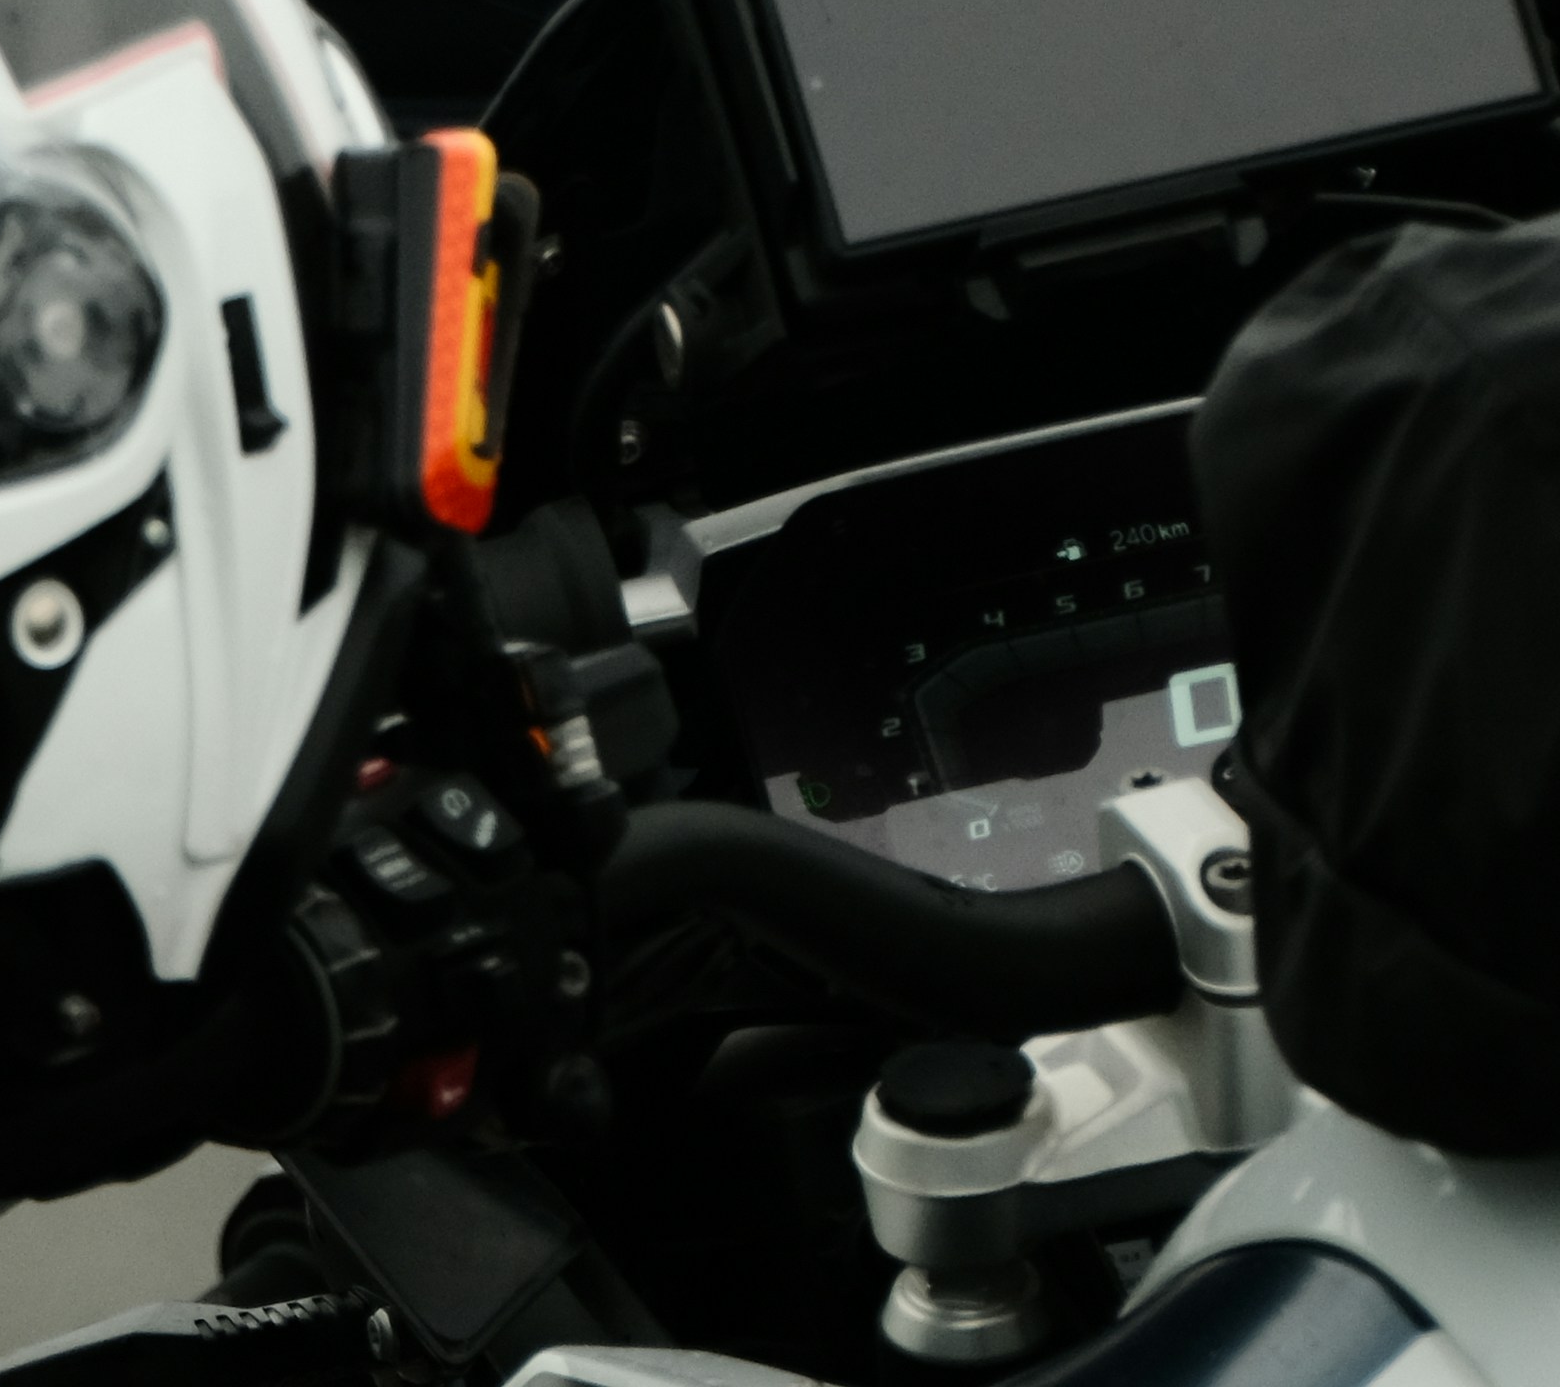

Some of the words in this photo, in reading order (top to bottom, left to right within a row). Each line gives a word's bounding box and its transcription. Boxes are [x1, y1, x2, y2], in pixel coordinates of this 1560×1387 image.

[1123, 579, 1146, 600] 6
[1055, 594, 1077, 615] 5
[983, 608, 1005, 628] 4
[905, 642, 927, 664] 3
[881, 716, 902, 738] 2
